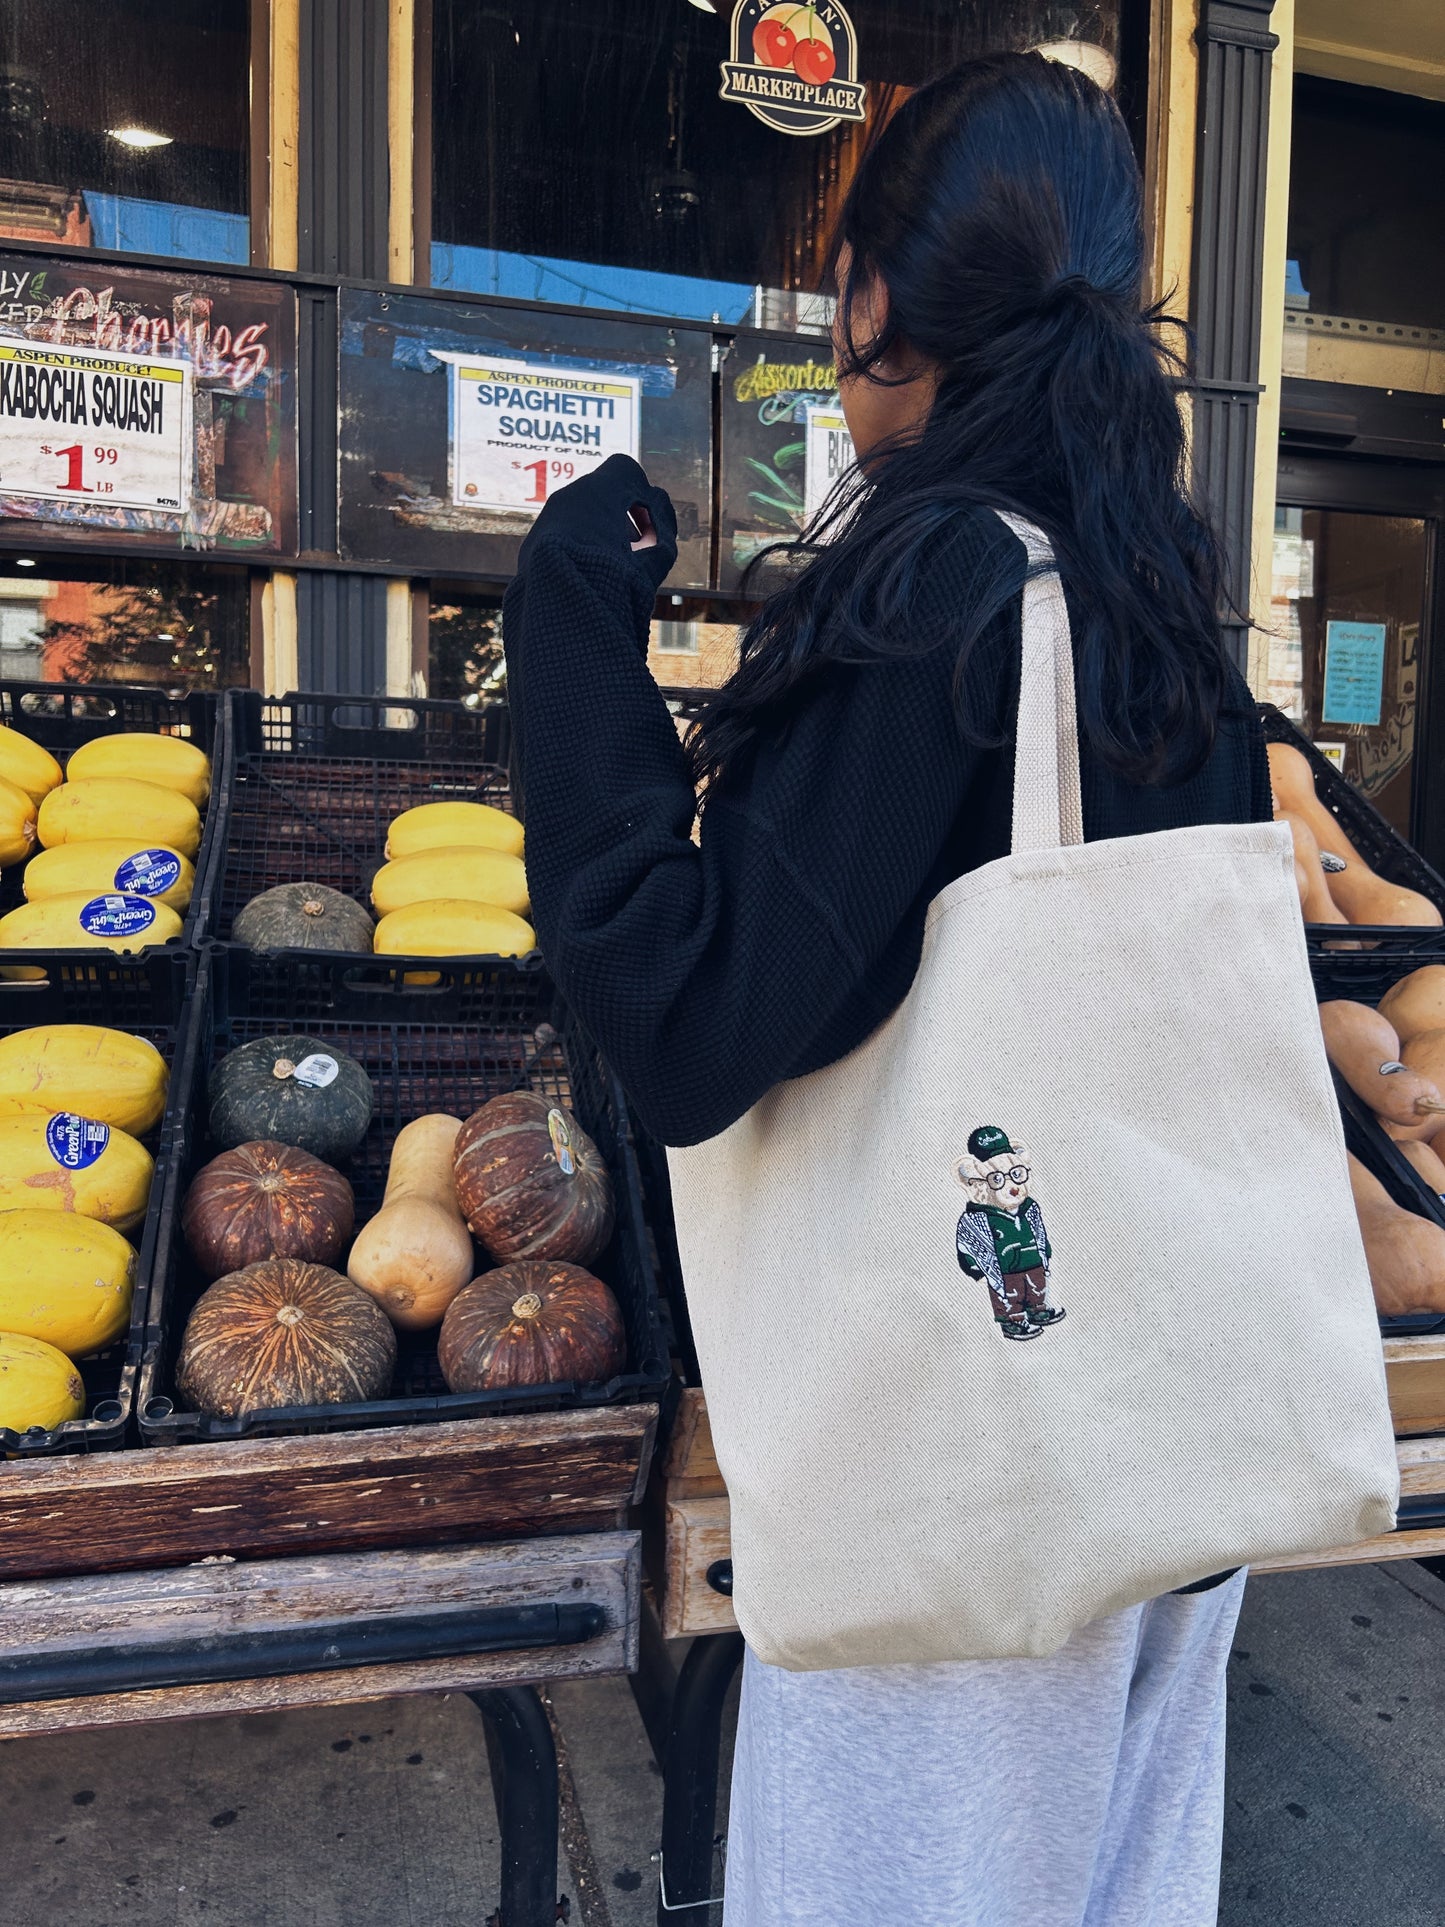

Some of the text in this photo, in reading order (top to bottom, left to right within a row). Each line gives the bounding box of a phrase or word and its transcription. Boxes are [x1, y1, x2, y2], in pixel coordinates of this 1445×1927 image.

[731, 71, 857, 110] MARKETPLACE
[13, 349, 152, 376] ASPEN PRODUCE!
[488, 371, 606, 393] ASPEN PRODUCE!
[0, 362, 164, 435] KABOCHA SQUASH
[477, 384, 615, 420] SPAGHETTI
[498, 415, 601, 447] SQUASH
[487, 439, 552, 452] PRODUCT
[575, 449, 603, 458] USA
[97, 481, 113, 493] LB
